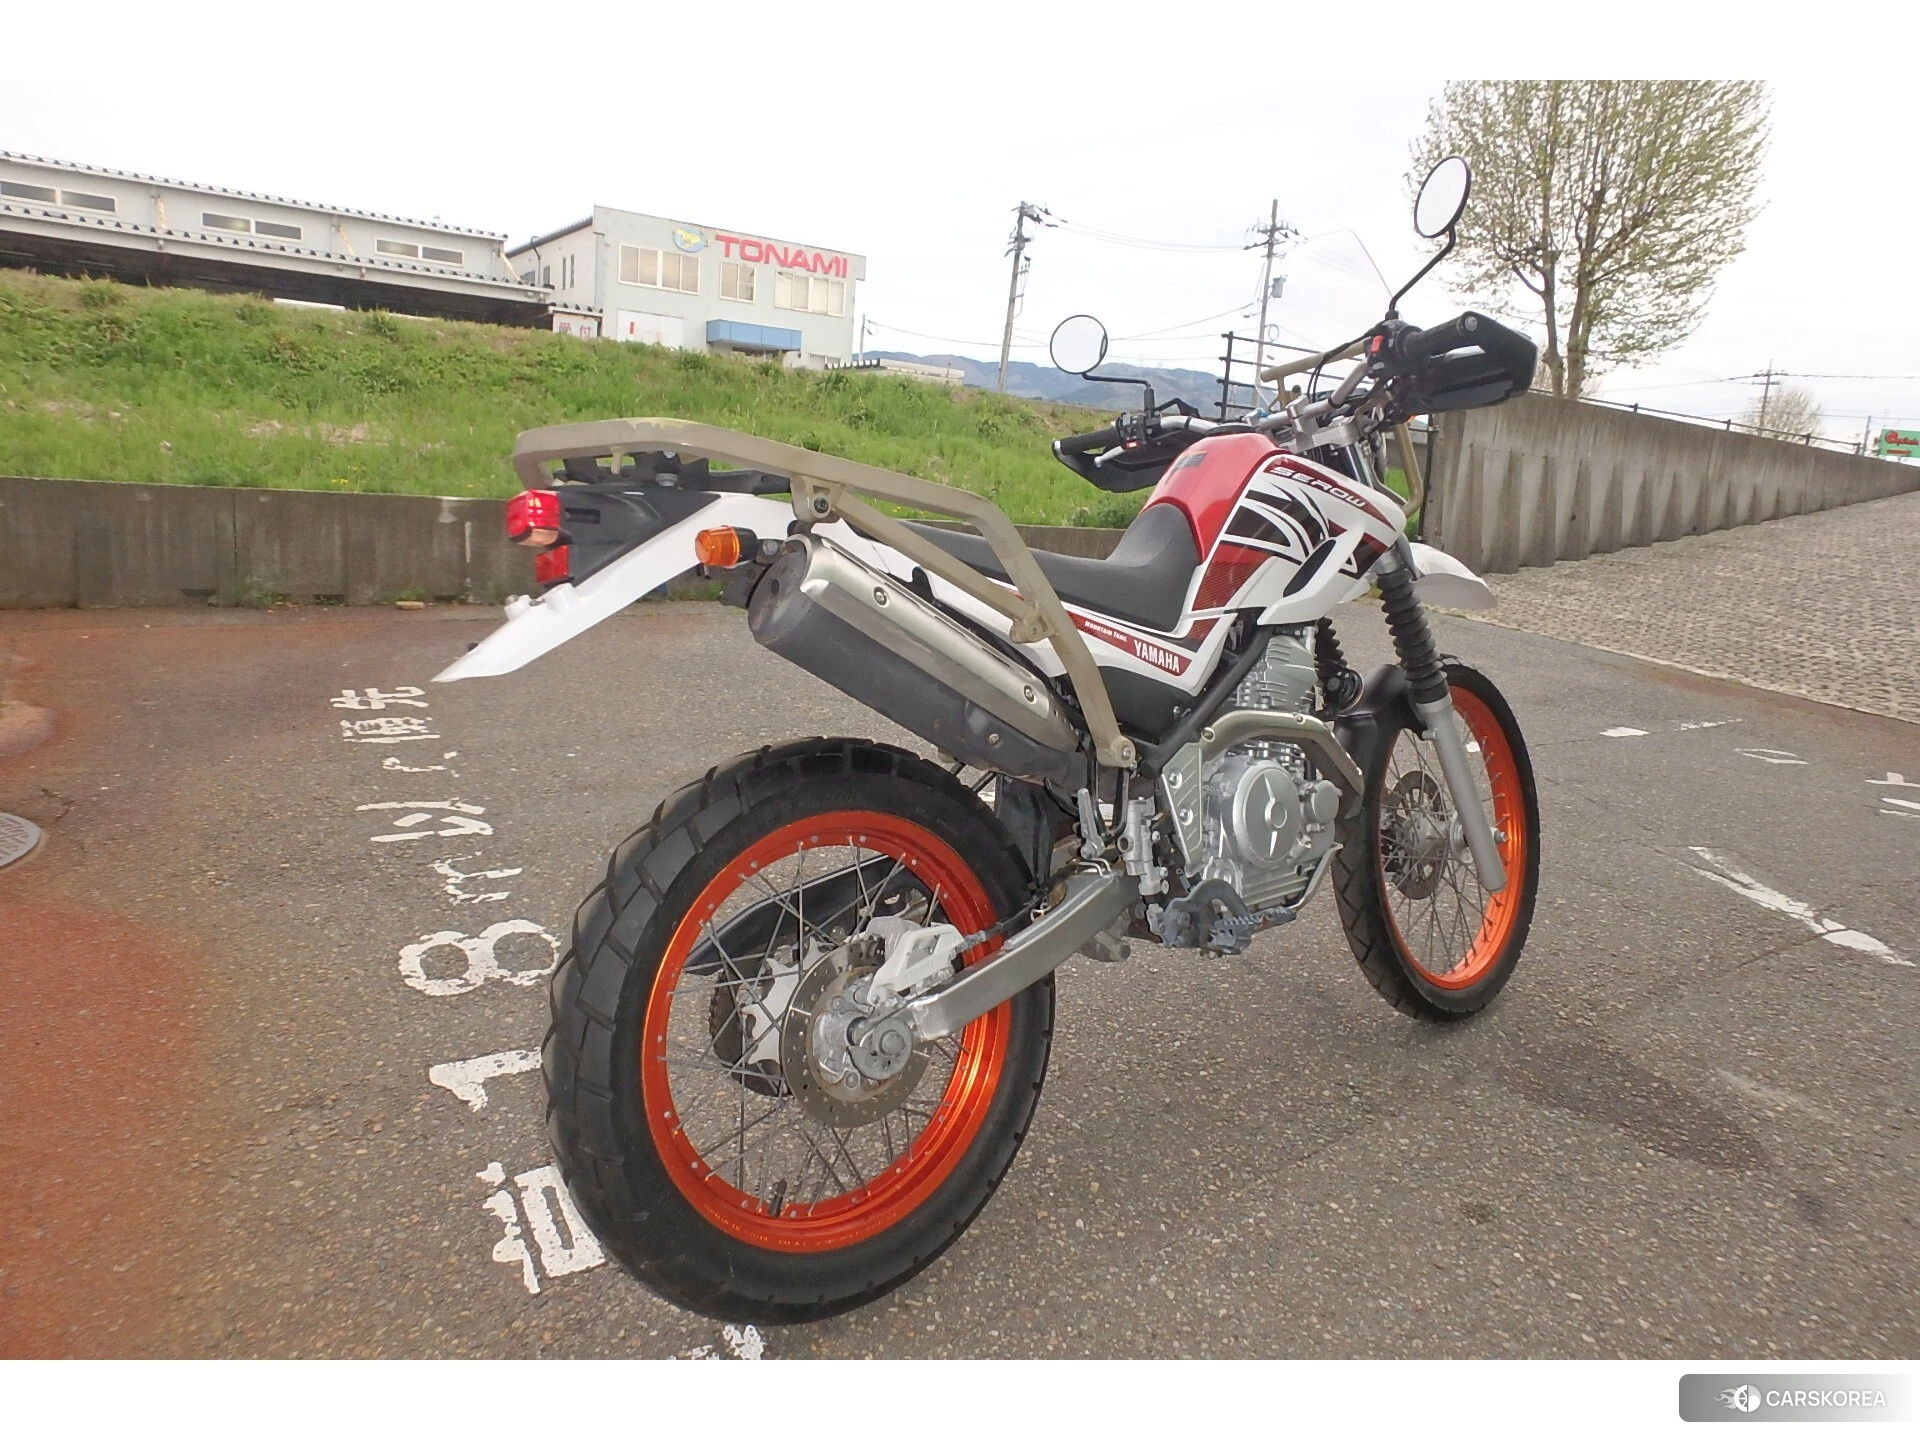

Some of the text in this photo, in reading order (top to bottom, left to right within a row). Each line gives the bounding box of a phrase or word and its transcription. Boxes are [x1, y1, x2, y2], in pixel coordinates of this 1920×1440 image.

[715, 233, 847, 278] TONAMI
[1270, 466, 1365, 507] SEROW
[1133, 639, 1180, 673] YAMAHA
